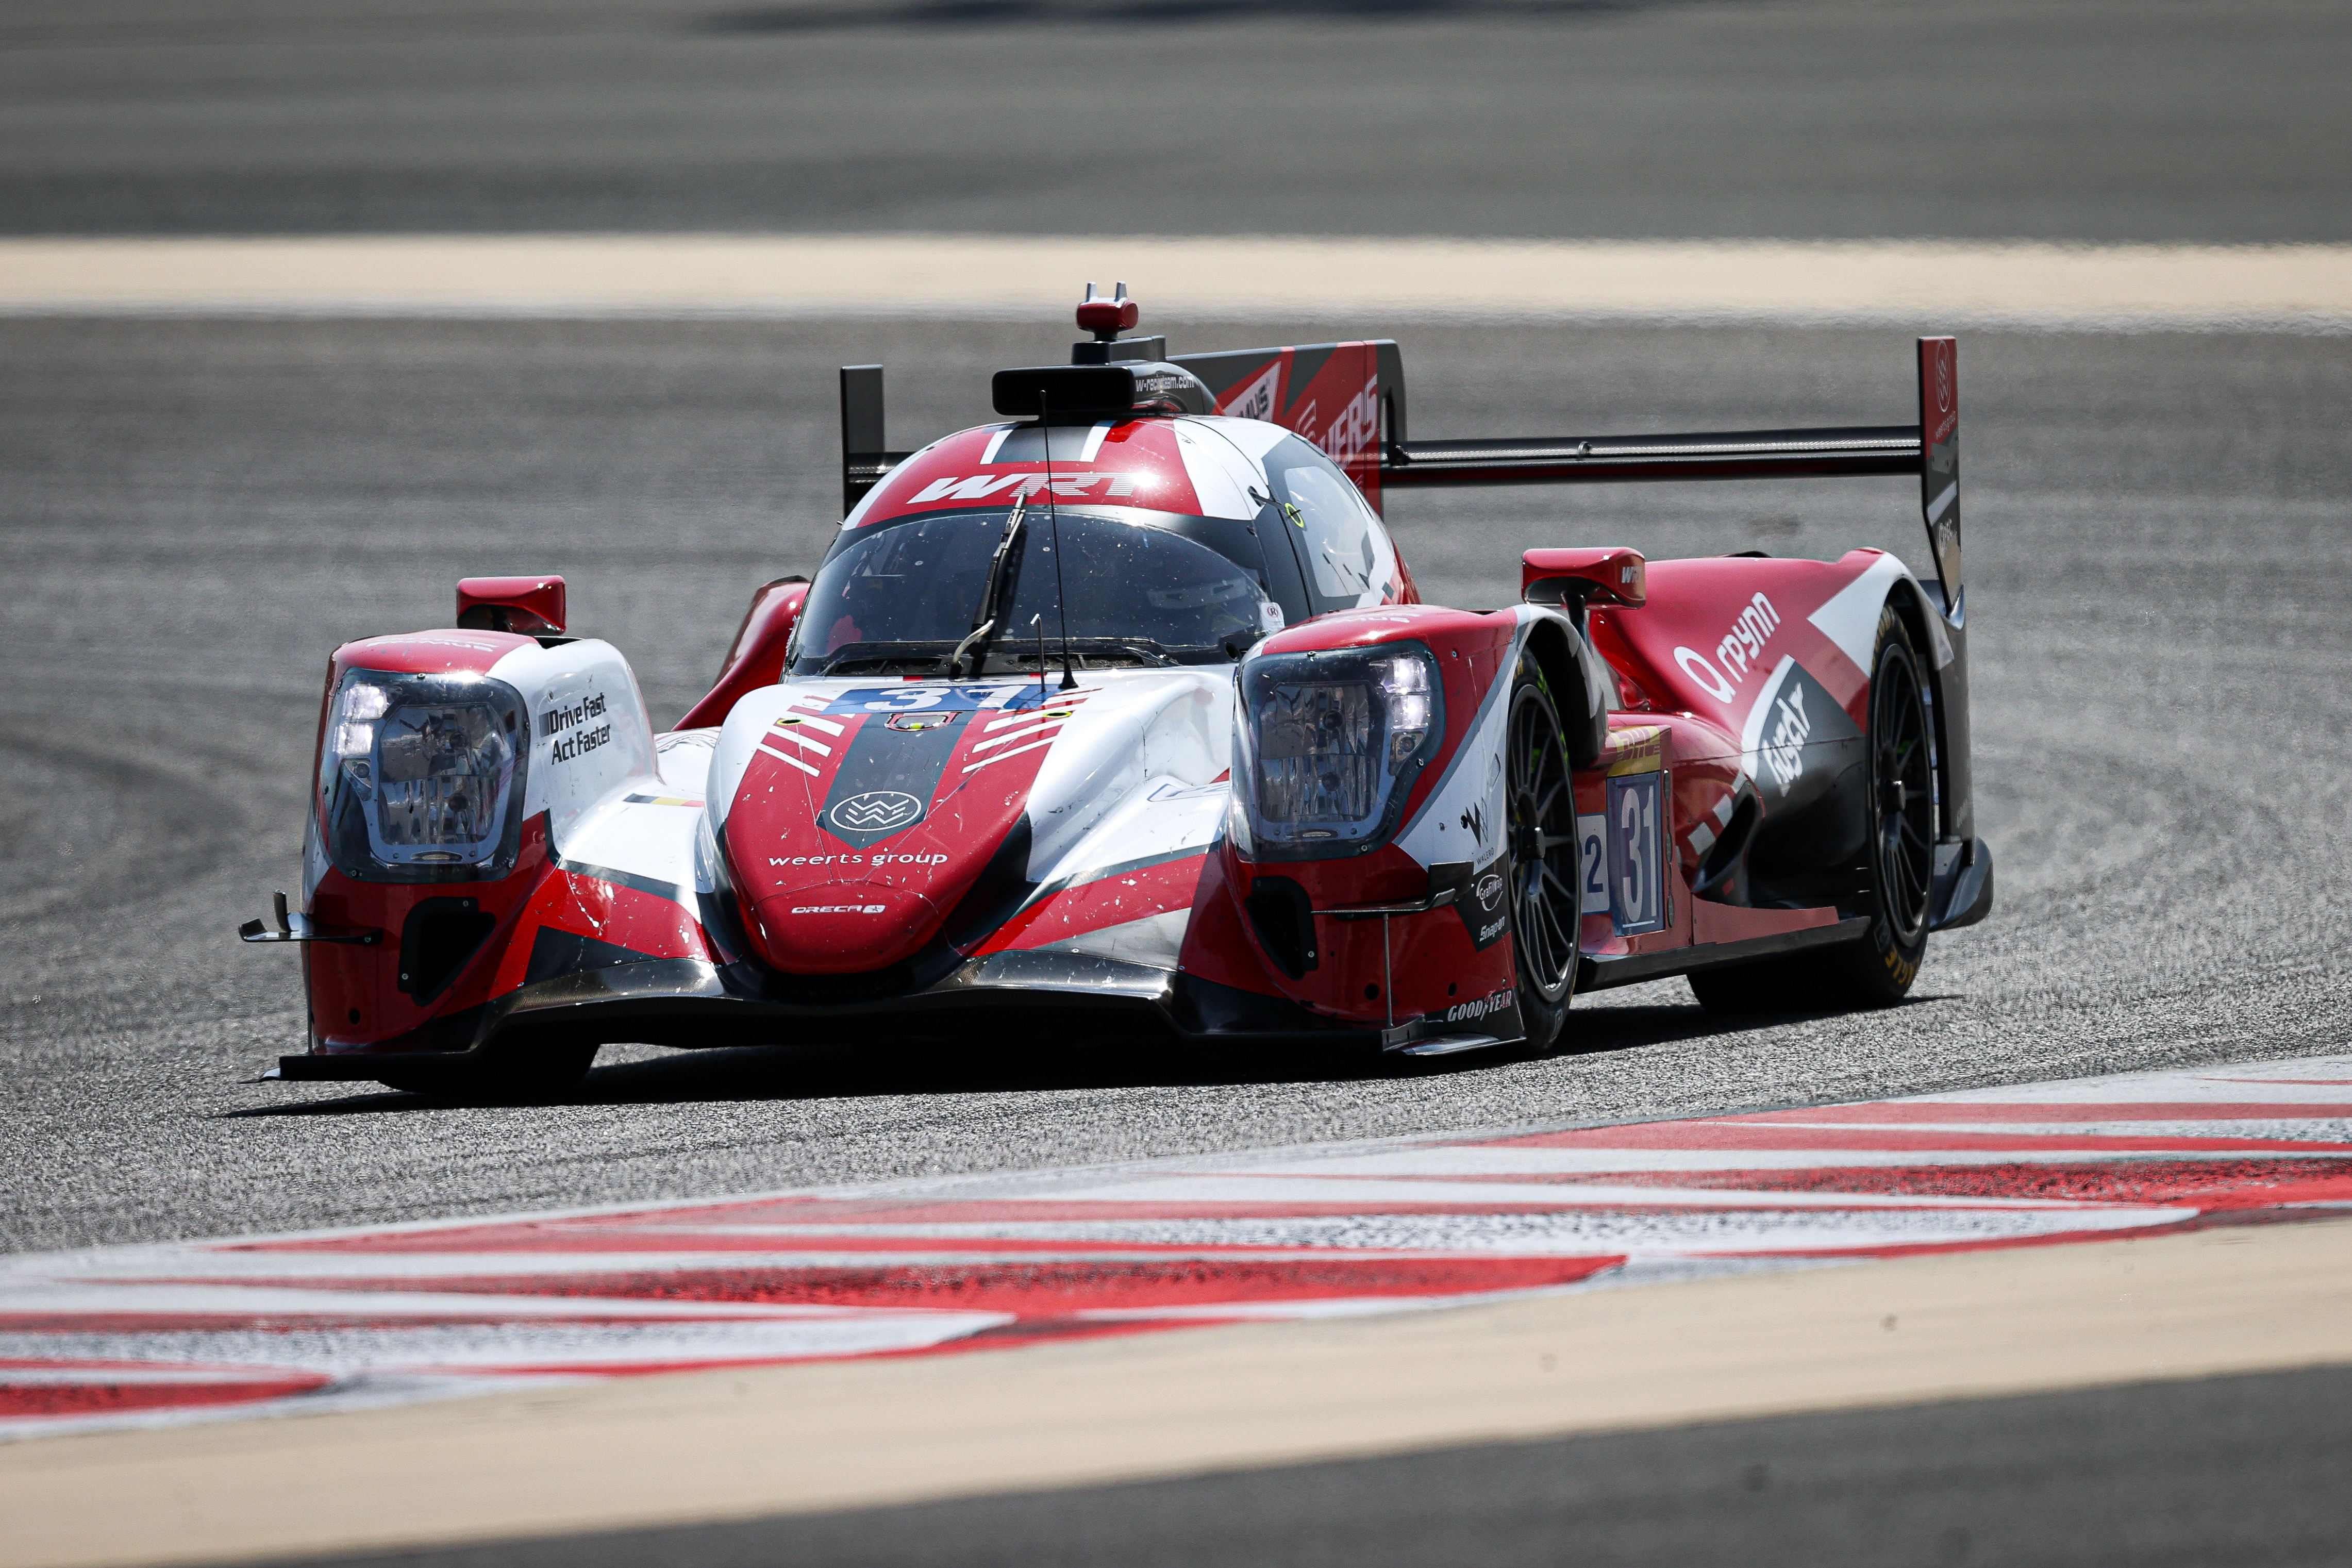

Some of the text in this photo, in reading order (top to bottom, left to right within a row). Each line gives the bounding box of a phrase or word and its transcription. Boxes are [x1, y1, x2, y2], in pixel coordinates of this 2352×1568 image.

[1136, 376, 1194, 392] w-raciteam.com
[906, 472, 1160, 504] WRT
[864, 686, 1028, 710] 31
[549, 692, 607, 735] Drive Fast
[552, 724, 611, 765] Act Faster
[768, 853, 948, 867] weerts group
[1476, 847, 1494, 865] WALERO
[1579, 834, 1604, 894] 2
[1621, 784, 1657, 923] 31
[791, 905, 863, 915] ORECA
